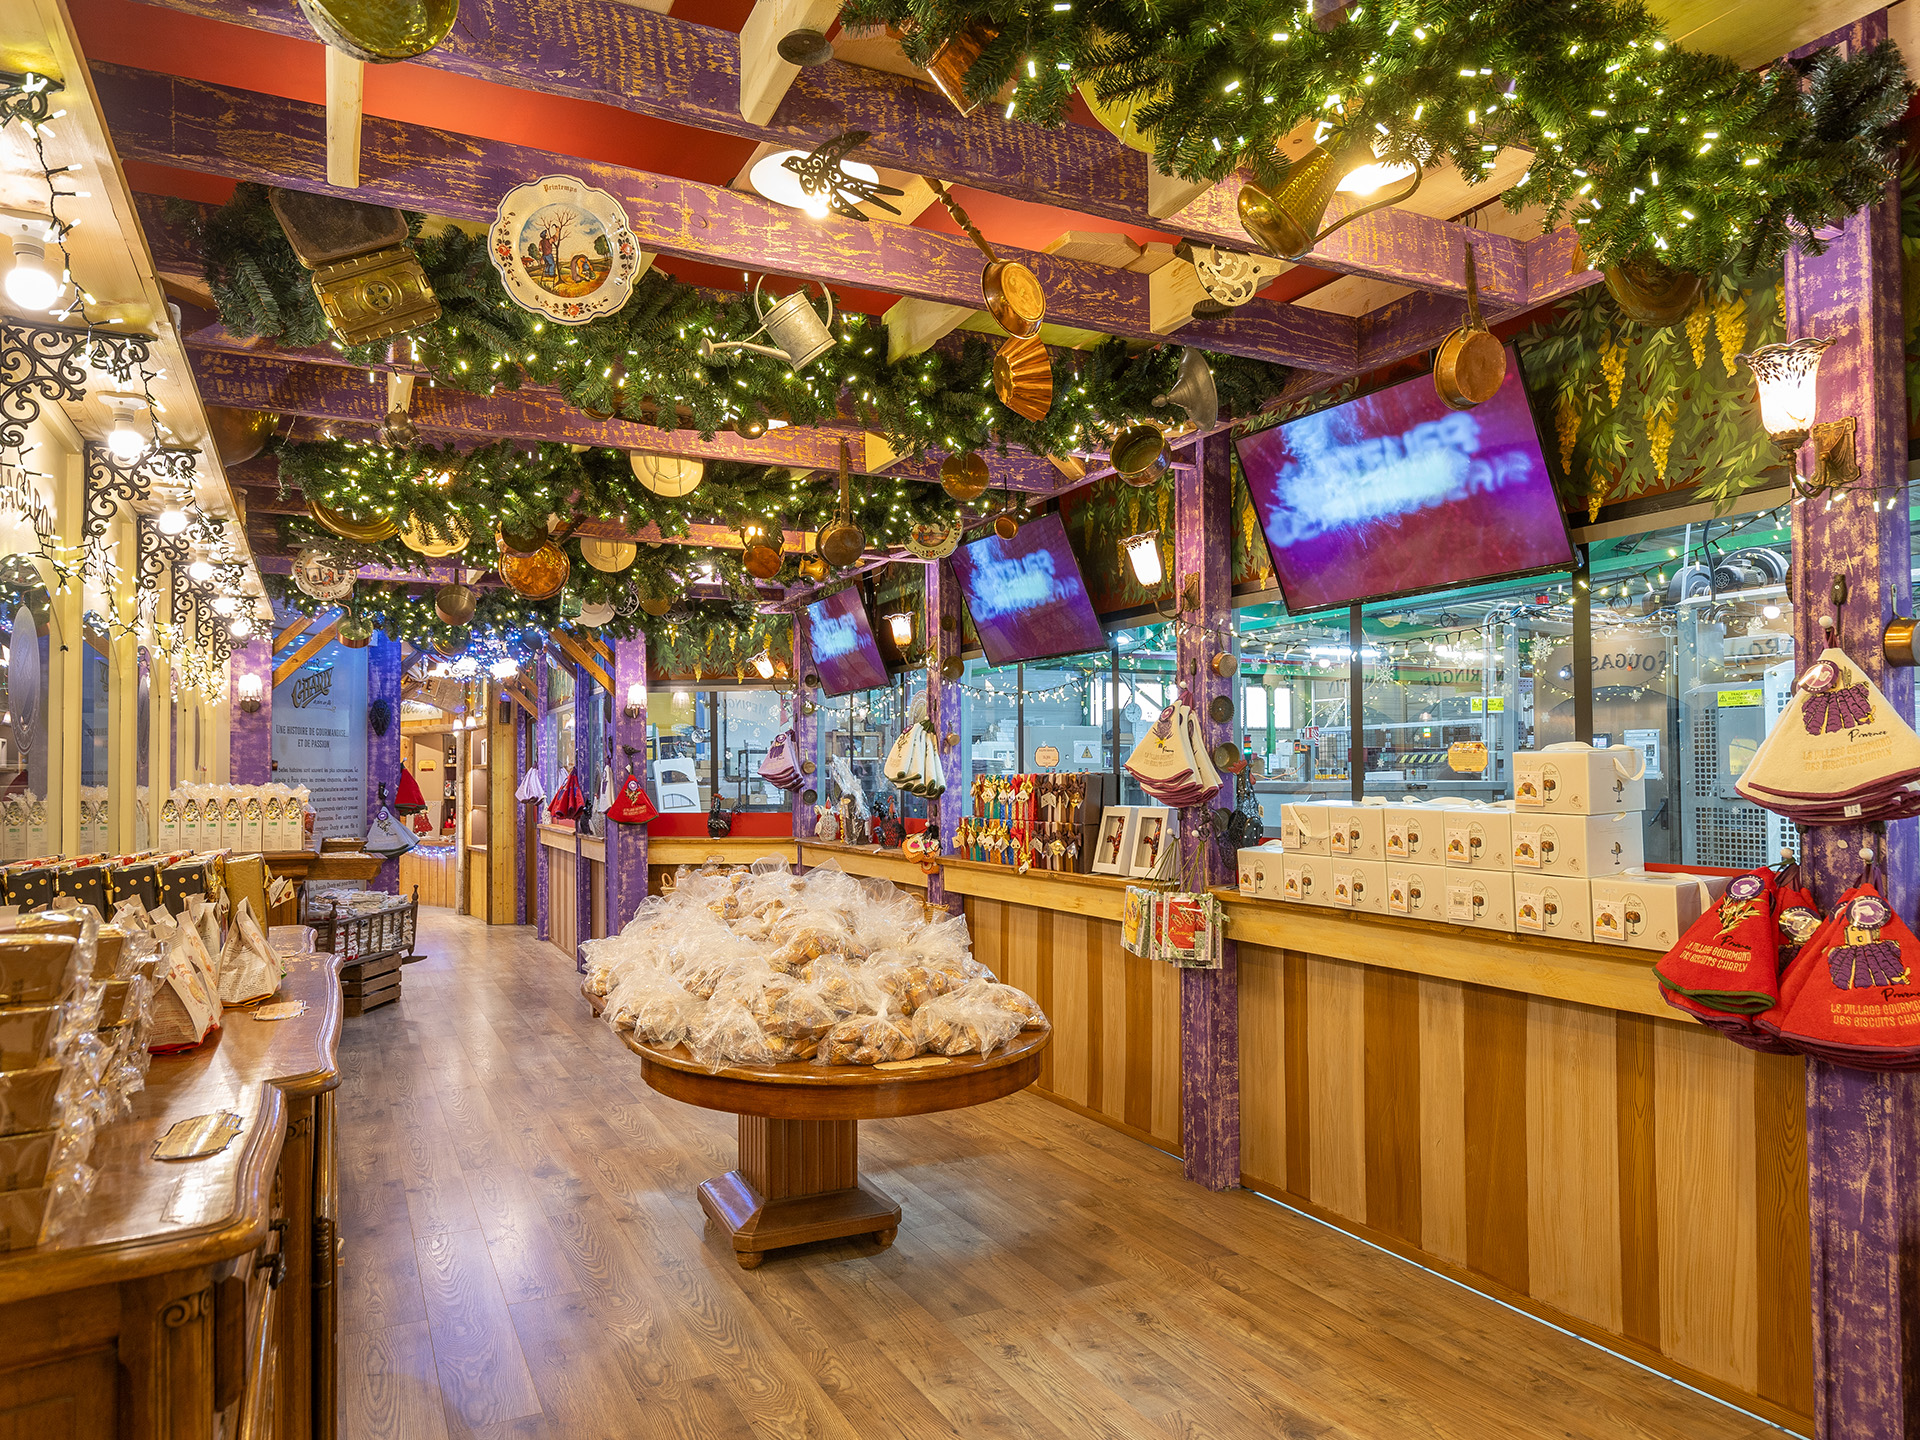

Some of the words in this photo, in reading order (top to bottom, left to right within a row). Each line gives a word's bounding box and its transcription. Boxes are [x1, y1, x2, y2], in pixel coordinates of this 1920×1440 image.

[543, 184, 577, 192] Printemps
[291, 667, 334, 709] CHARLY
[276, 725, 286, 734] UNE
[287, 726, 308, 735] HISTOIRE
[309, 727, 315, 735] DE
[1848, 729, 1887, 742] Provence
[298, 739, 303, 747] ET
[304, 740, 310, 748] DE
[1815, 746, 1845, 759] VILLAGE
[1846, 735, 1892, 755] GOURMAND
[1805, 762, 1820, 771] DES
[1822, 756, 1857, 770] BISCUITS
[1859, 747, 1892, 764] CHARLY
[1712, 947, 1752, 961] GOURMAND
[1689, 953, 1717, 967] BISCUITS
[1717, 959, 1748, 972] CHARLY
[1830, 1003, 1842, 1014] LE
[1844, 1003, 1881, 1015] VILLAGE
[1882, 1000, 1920, 1014] GOURMA
[1833, 1015, 1852, 1026] DES
[1854, 1016, 1896, 1027] BISCUITS
